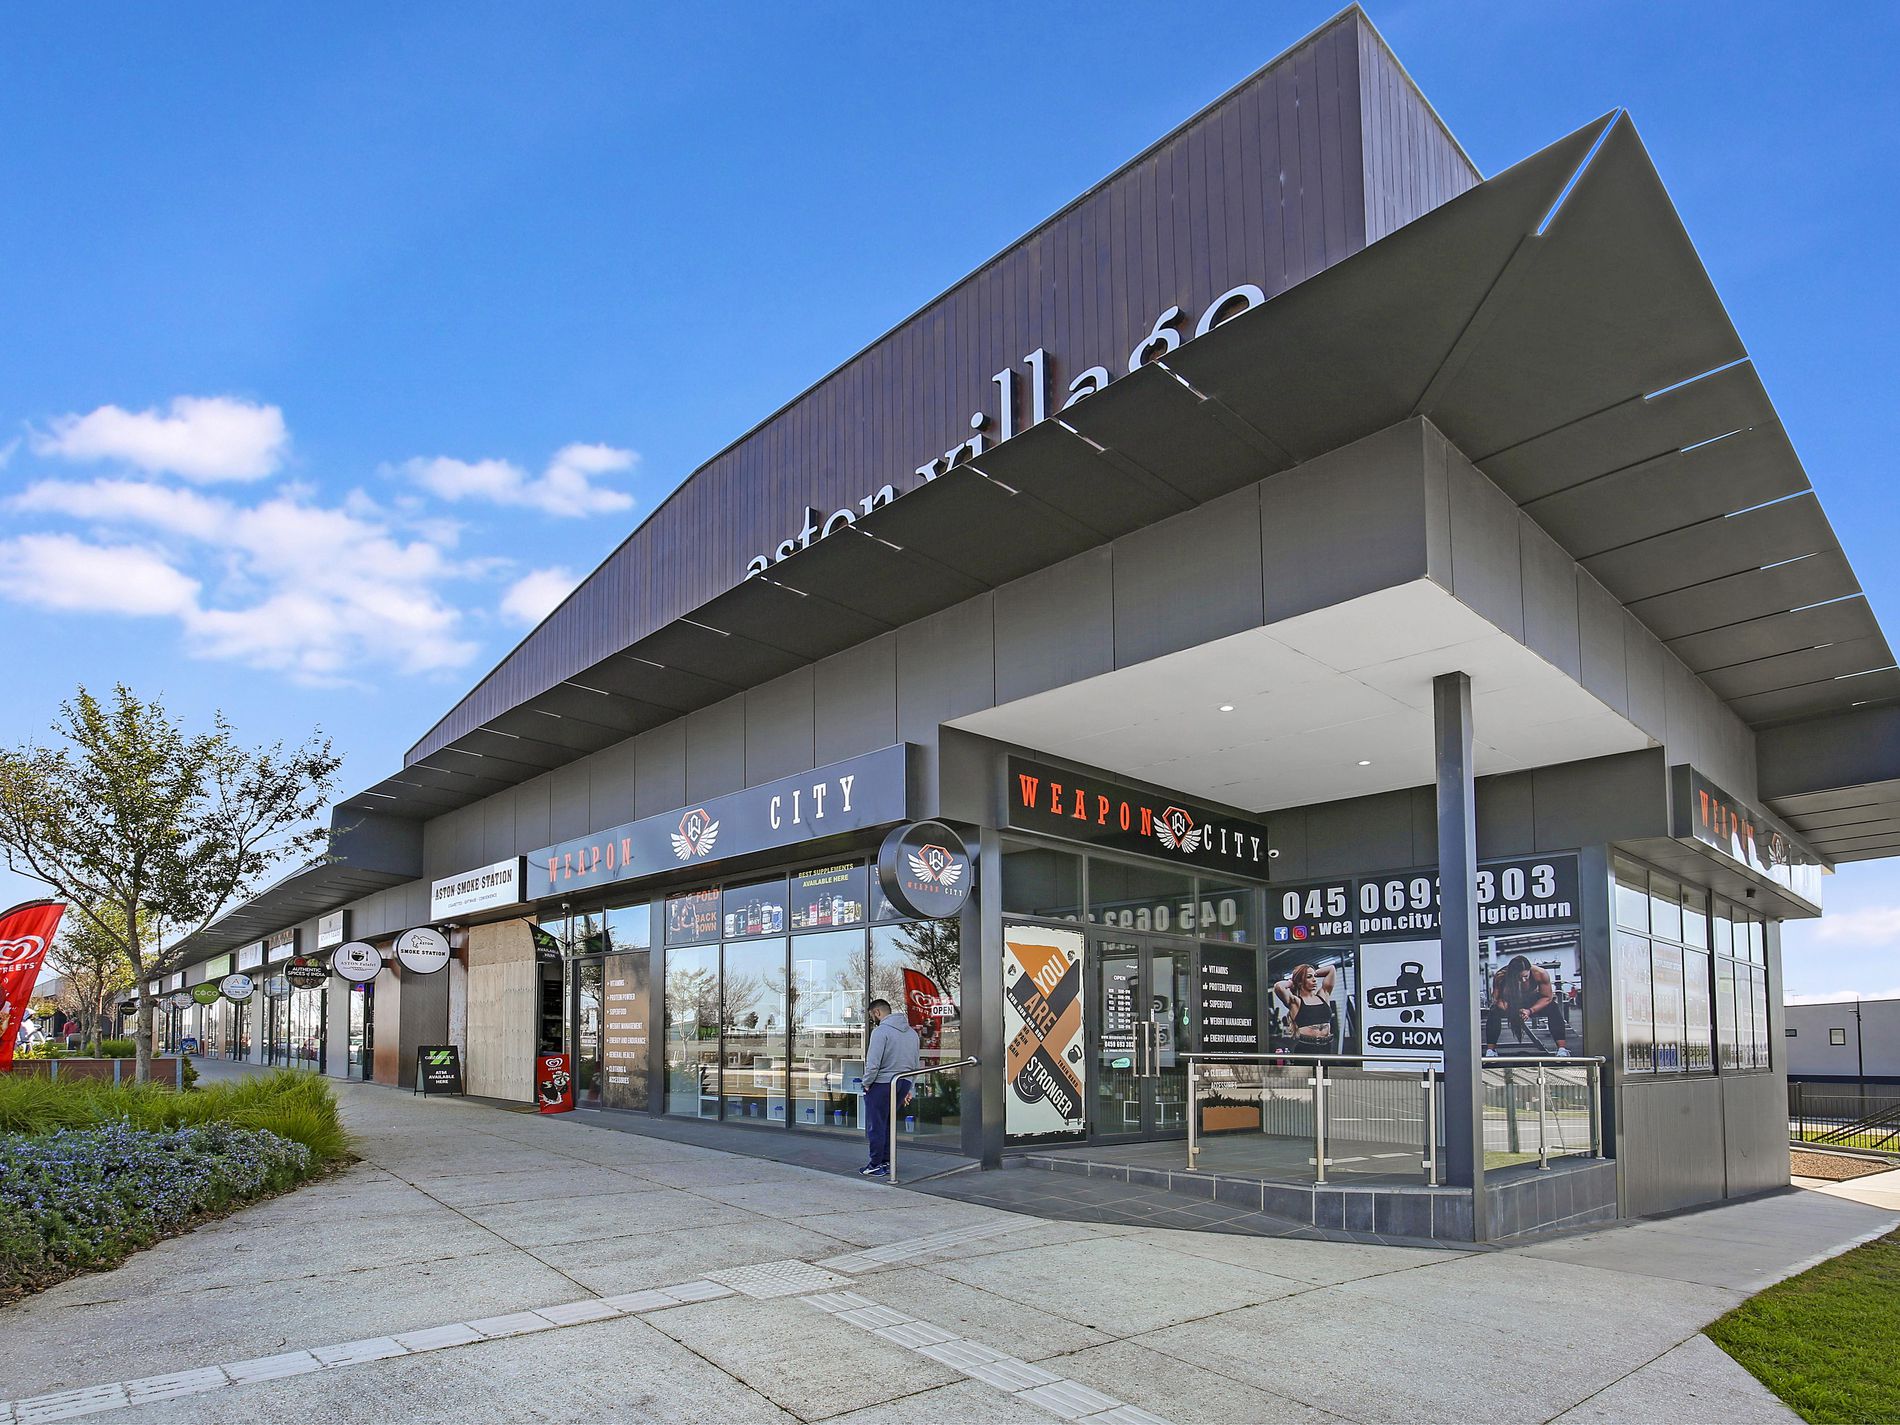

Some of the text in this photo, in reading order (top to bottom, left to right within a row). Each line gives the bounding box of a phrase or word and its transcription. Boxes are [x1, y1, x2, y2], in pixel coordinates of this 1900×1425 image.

[1018, 774, 1260, 862] WEAPON CITY
[1699, 789, 1754, 849] WEAPON
[547, 775, 854, 883] WEAPON CITY
[798, 863, 854, 879] BEST SUPPLEMENTS
[435, 868, 513, 901] ASTON SMOKE STATION
[802, 873, 849, 888] AVAILABLE HERE
[696, 888, 720, 903] FOLD
[907, 881, 963, 896] WEAPON CITY
[1282, 886, 1346, 921] 045
[1360, 877, 1440, 913] 069
[0, 962, 36, 974] REETS
[1033, 954, 1065, 994] YOU
[1208, 965, 1229, 975] VITAMINS
[1208, 982, 1243, 993] PROTEIN POWDER
[1373, 985, 1443, 1007] GET FIT
[932, 1006, 953, 1015] OPEN
[1209, 1000, 1233, 1009] SUPERFOOD
[1023, 991, 1058, 1035] ARE
[1400, 1009, 1426, 1024] OR
[1209, 1017, 1252, 1027] WEIGHT MANAGEMENT
[1022, 1026, 1030, 1036] NO
[1370, 1031, 1443, 1046] GO HOM
[1209, 1034, 1257, 1044] ENERGY AND ENDURANCE
[1026, 1056, 1073, 1118] STRONGER
